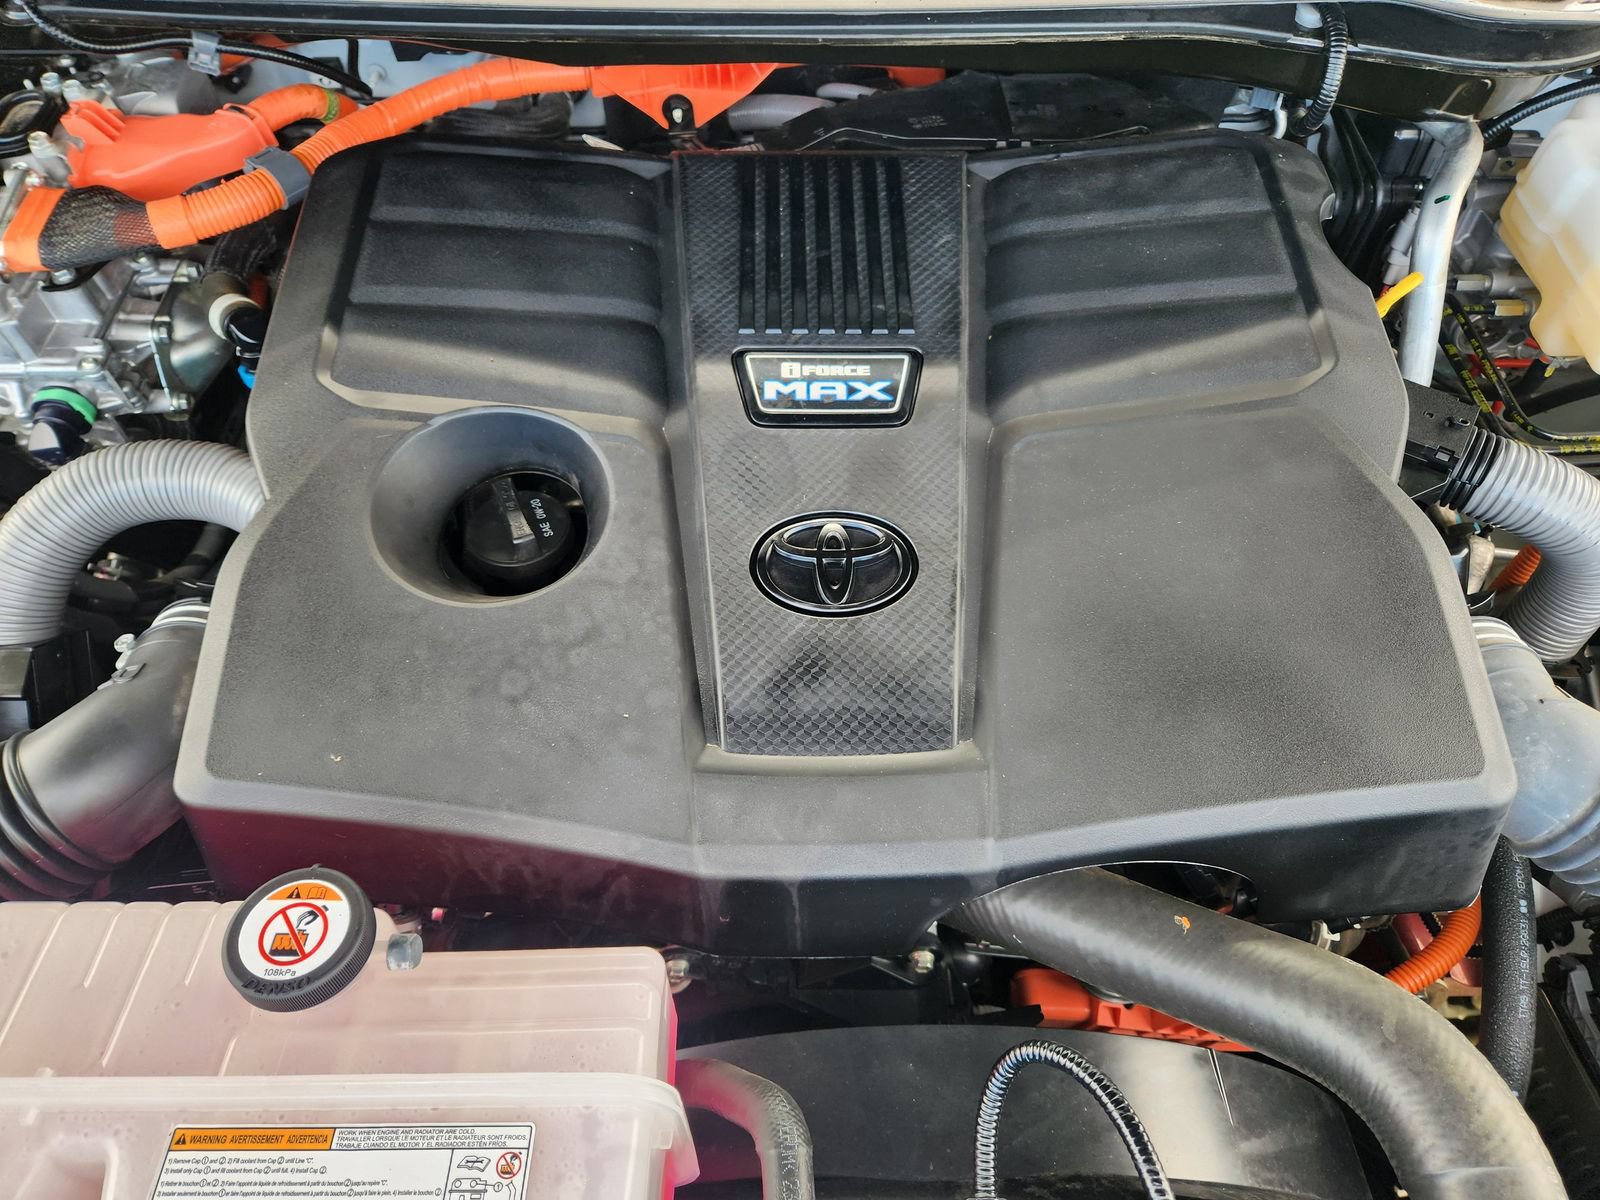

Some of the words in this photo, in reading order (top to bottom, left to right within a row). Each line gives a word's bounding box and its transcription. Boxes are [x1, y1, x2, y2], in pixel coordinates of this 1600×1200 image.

[763, 380, 894, 402] MAX
[530, 498, 546, 520] 0W-20
[540, 522, 554, 537] SAE
[264, 968, 296, 976] 108kPa
[241, 976, 312, 996] DENSO
[190, 1135, 226, 1144] WARNING
[229, 1135, 284, 1144] AVERTISSEMENT
[286, 1135, 328, 1144] ADVERTENCIA
